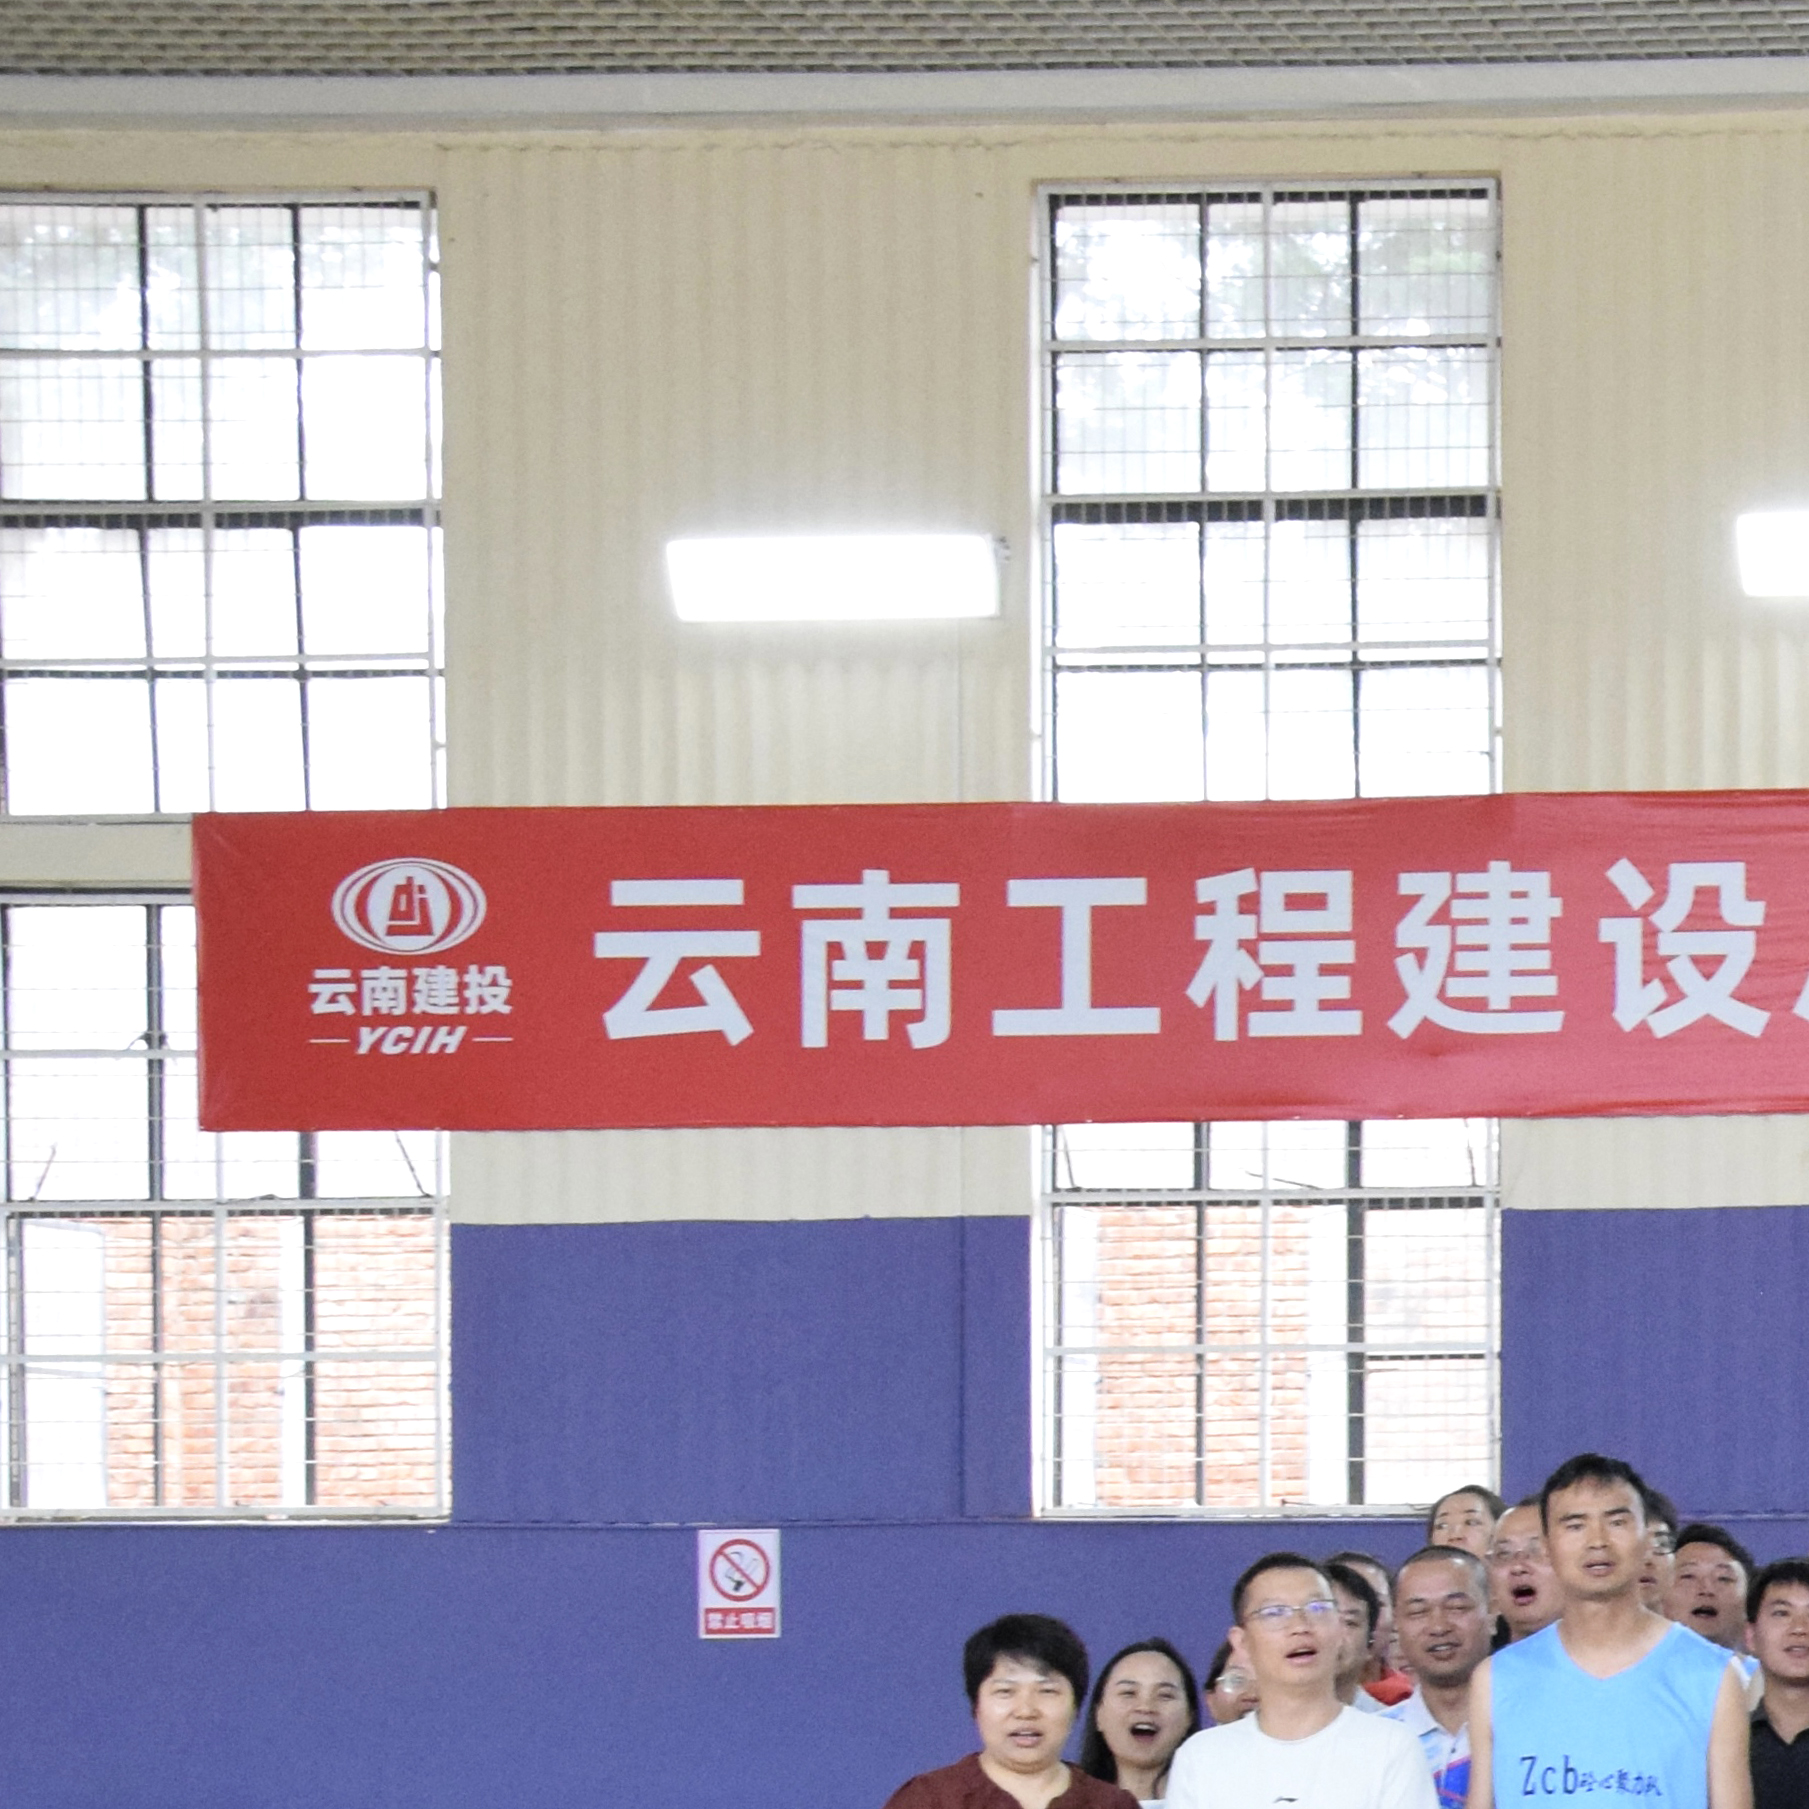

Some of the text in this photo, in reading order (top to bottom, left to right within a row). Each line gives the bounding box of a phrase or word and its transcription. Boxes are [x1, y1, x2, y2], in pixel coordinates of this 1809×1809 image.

[308, 965, 513, 1016] 云南建投
[356, 1026, 468, 1055] YCIH
